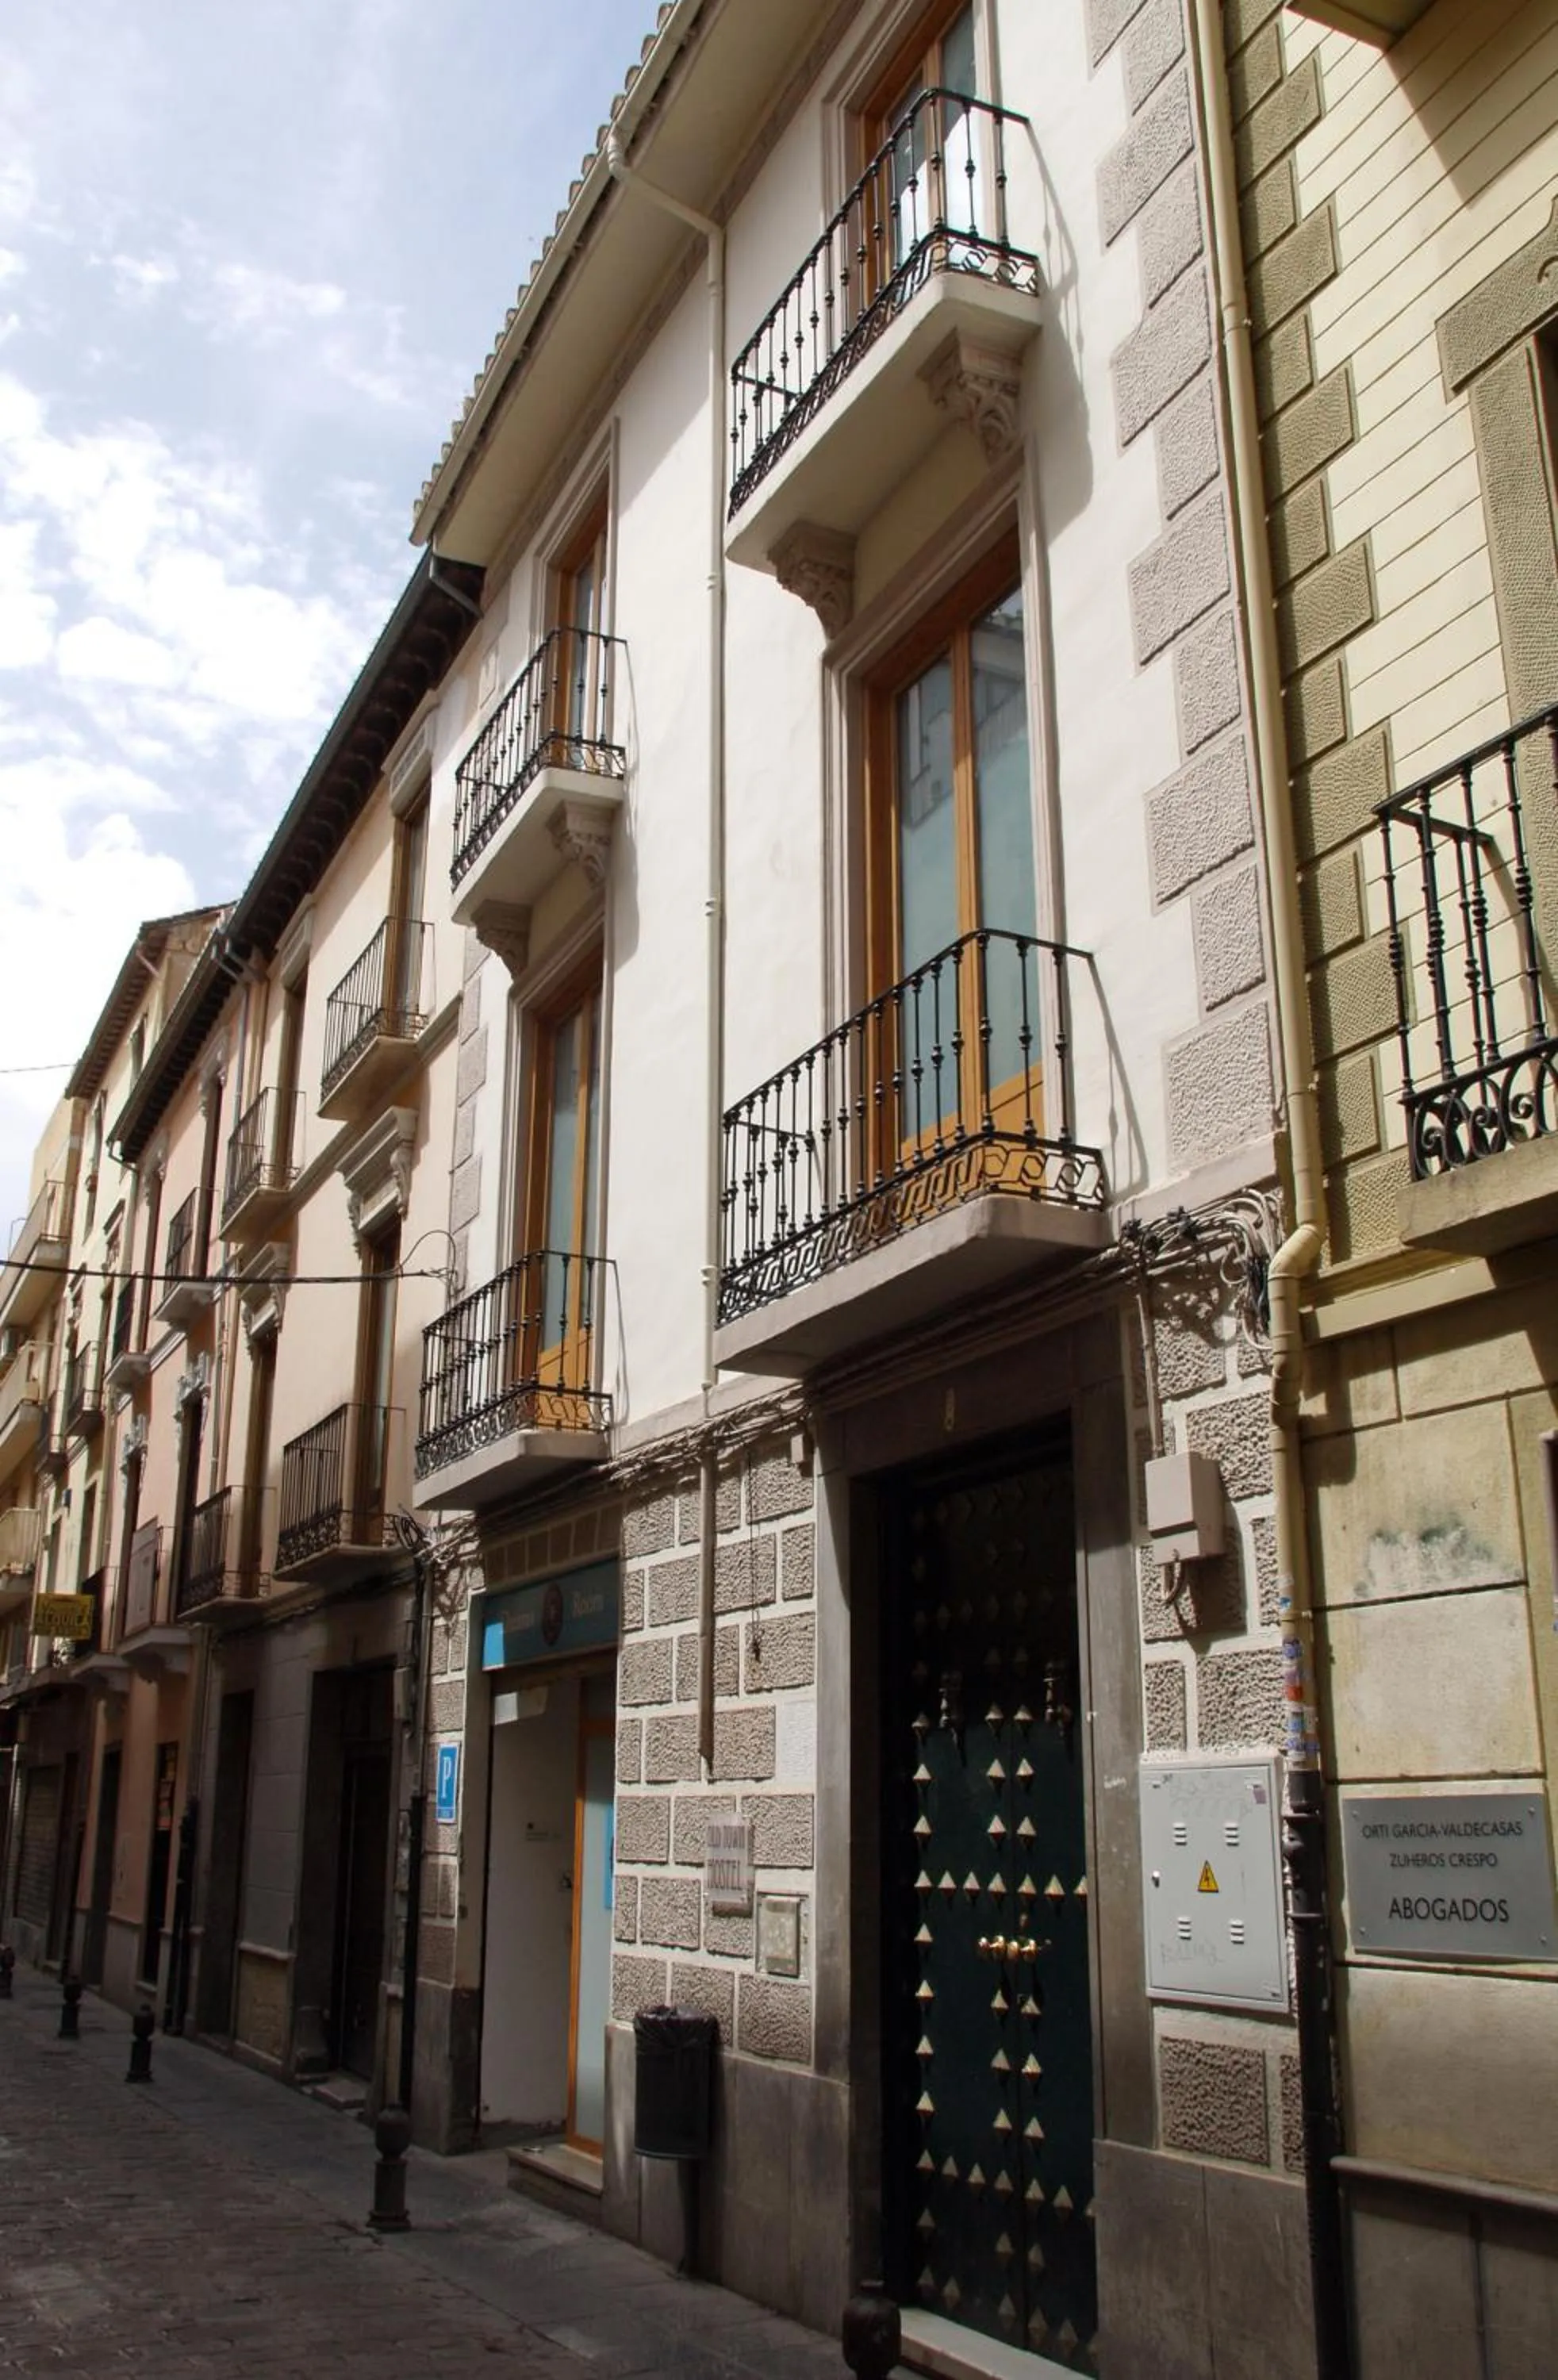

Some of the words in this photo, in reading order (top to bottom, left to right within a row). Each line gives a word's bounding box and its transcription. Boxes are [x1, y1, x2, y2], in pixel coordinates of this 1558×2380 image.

[441, 1756, 452, 1798] P
[1449, 1853, 1498, 1867] CRESPO
[1389, 1897, 1510, 1923] ABOGADOS
